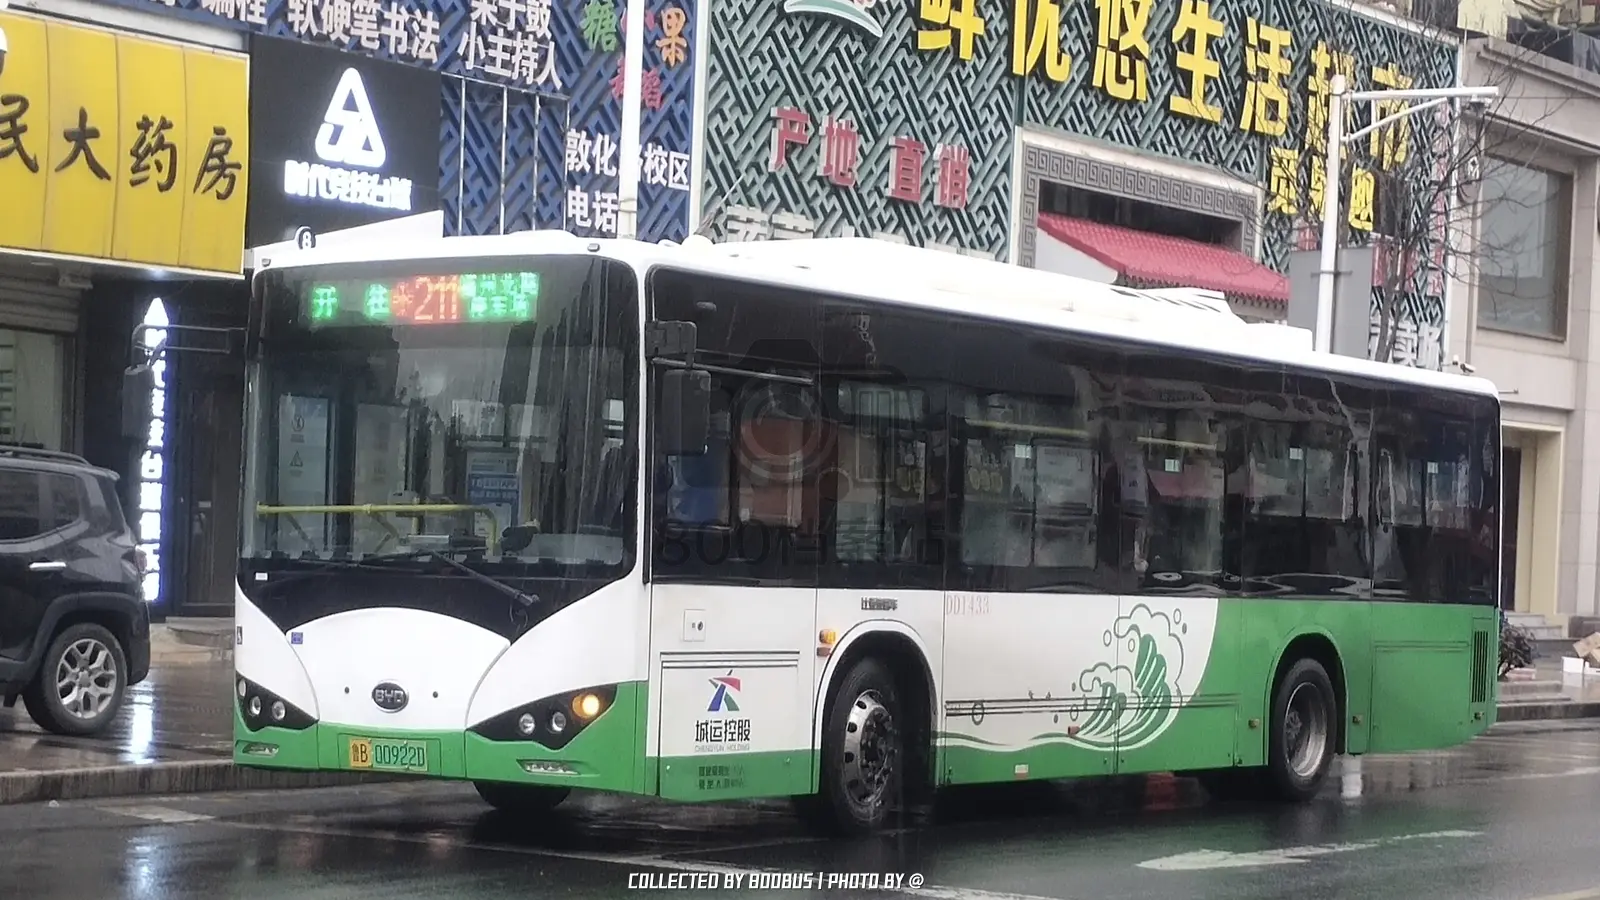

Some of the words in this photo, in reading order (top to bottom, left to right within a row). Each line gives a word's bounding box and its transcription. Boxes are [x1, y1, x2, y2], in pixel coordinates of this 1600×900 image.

[457, 22, 563, 90] 小主持人
[565, 127, 690, 191] 敦化校区
[567, 185, 618, 233] 电话
[415, 275, 458, 320] 211
[375, 689, 404, 704] BYD
[695, 719, 751, 743] 城运控股
[375, 745, 425, 767] 00922D
